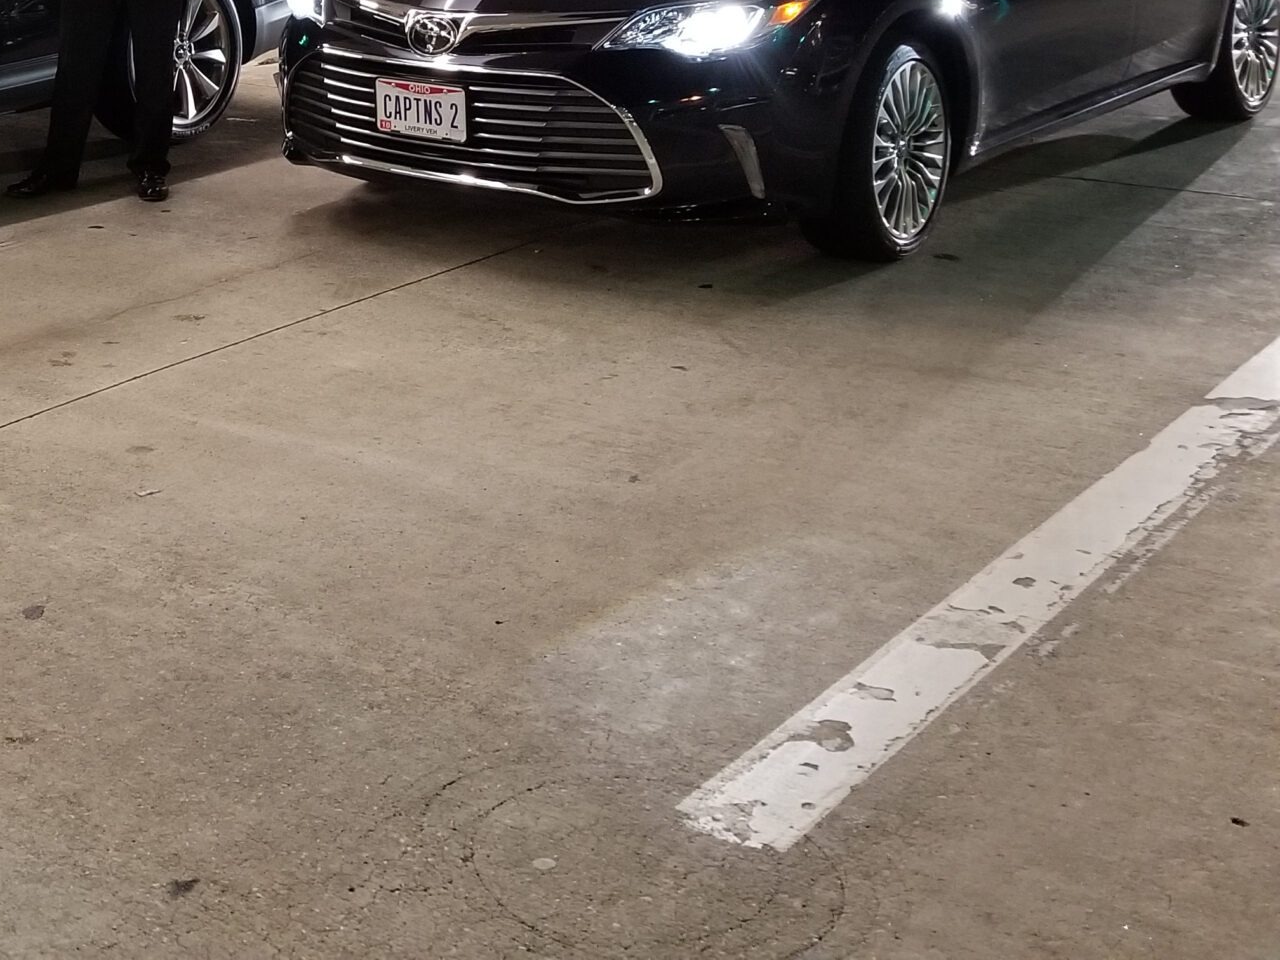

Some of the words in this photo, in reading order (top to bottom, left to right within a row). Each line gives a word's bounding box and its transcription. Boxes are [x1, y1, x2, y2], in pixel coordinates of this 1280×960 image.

[409, 85, 431, 94] OHIO
[383, 94, 442, 126] CAPTNS
[450, 103, 459, 129] 2
